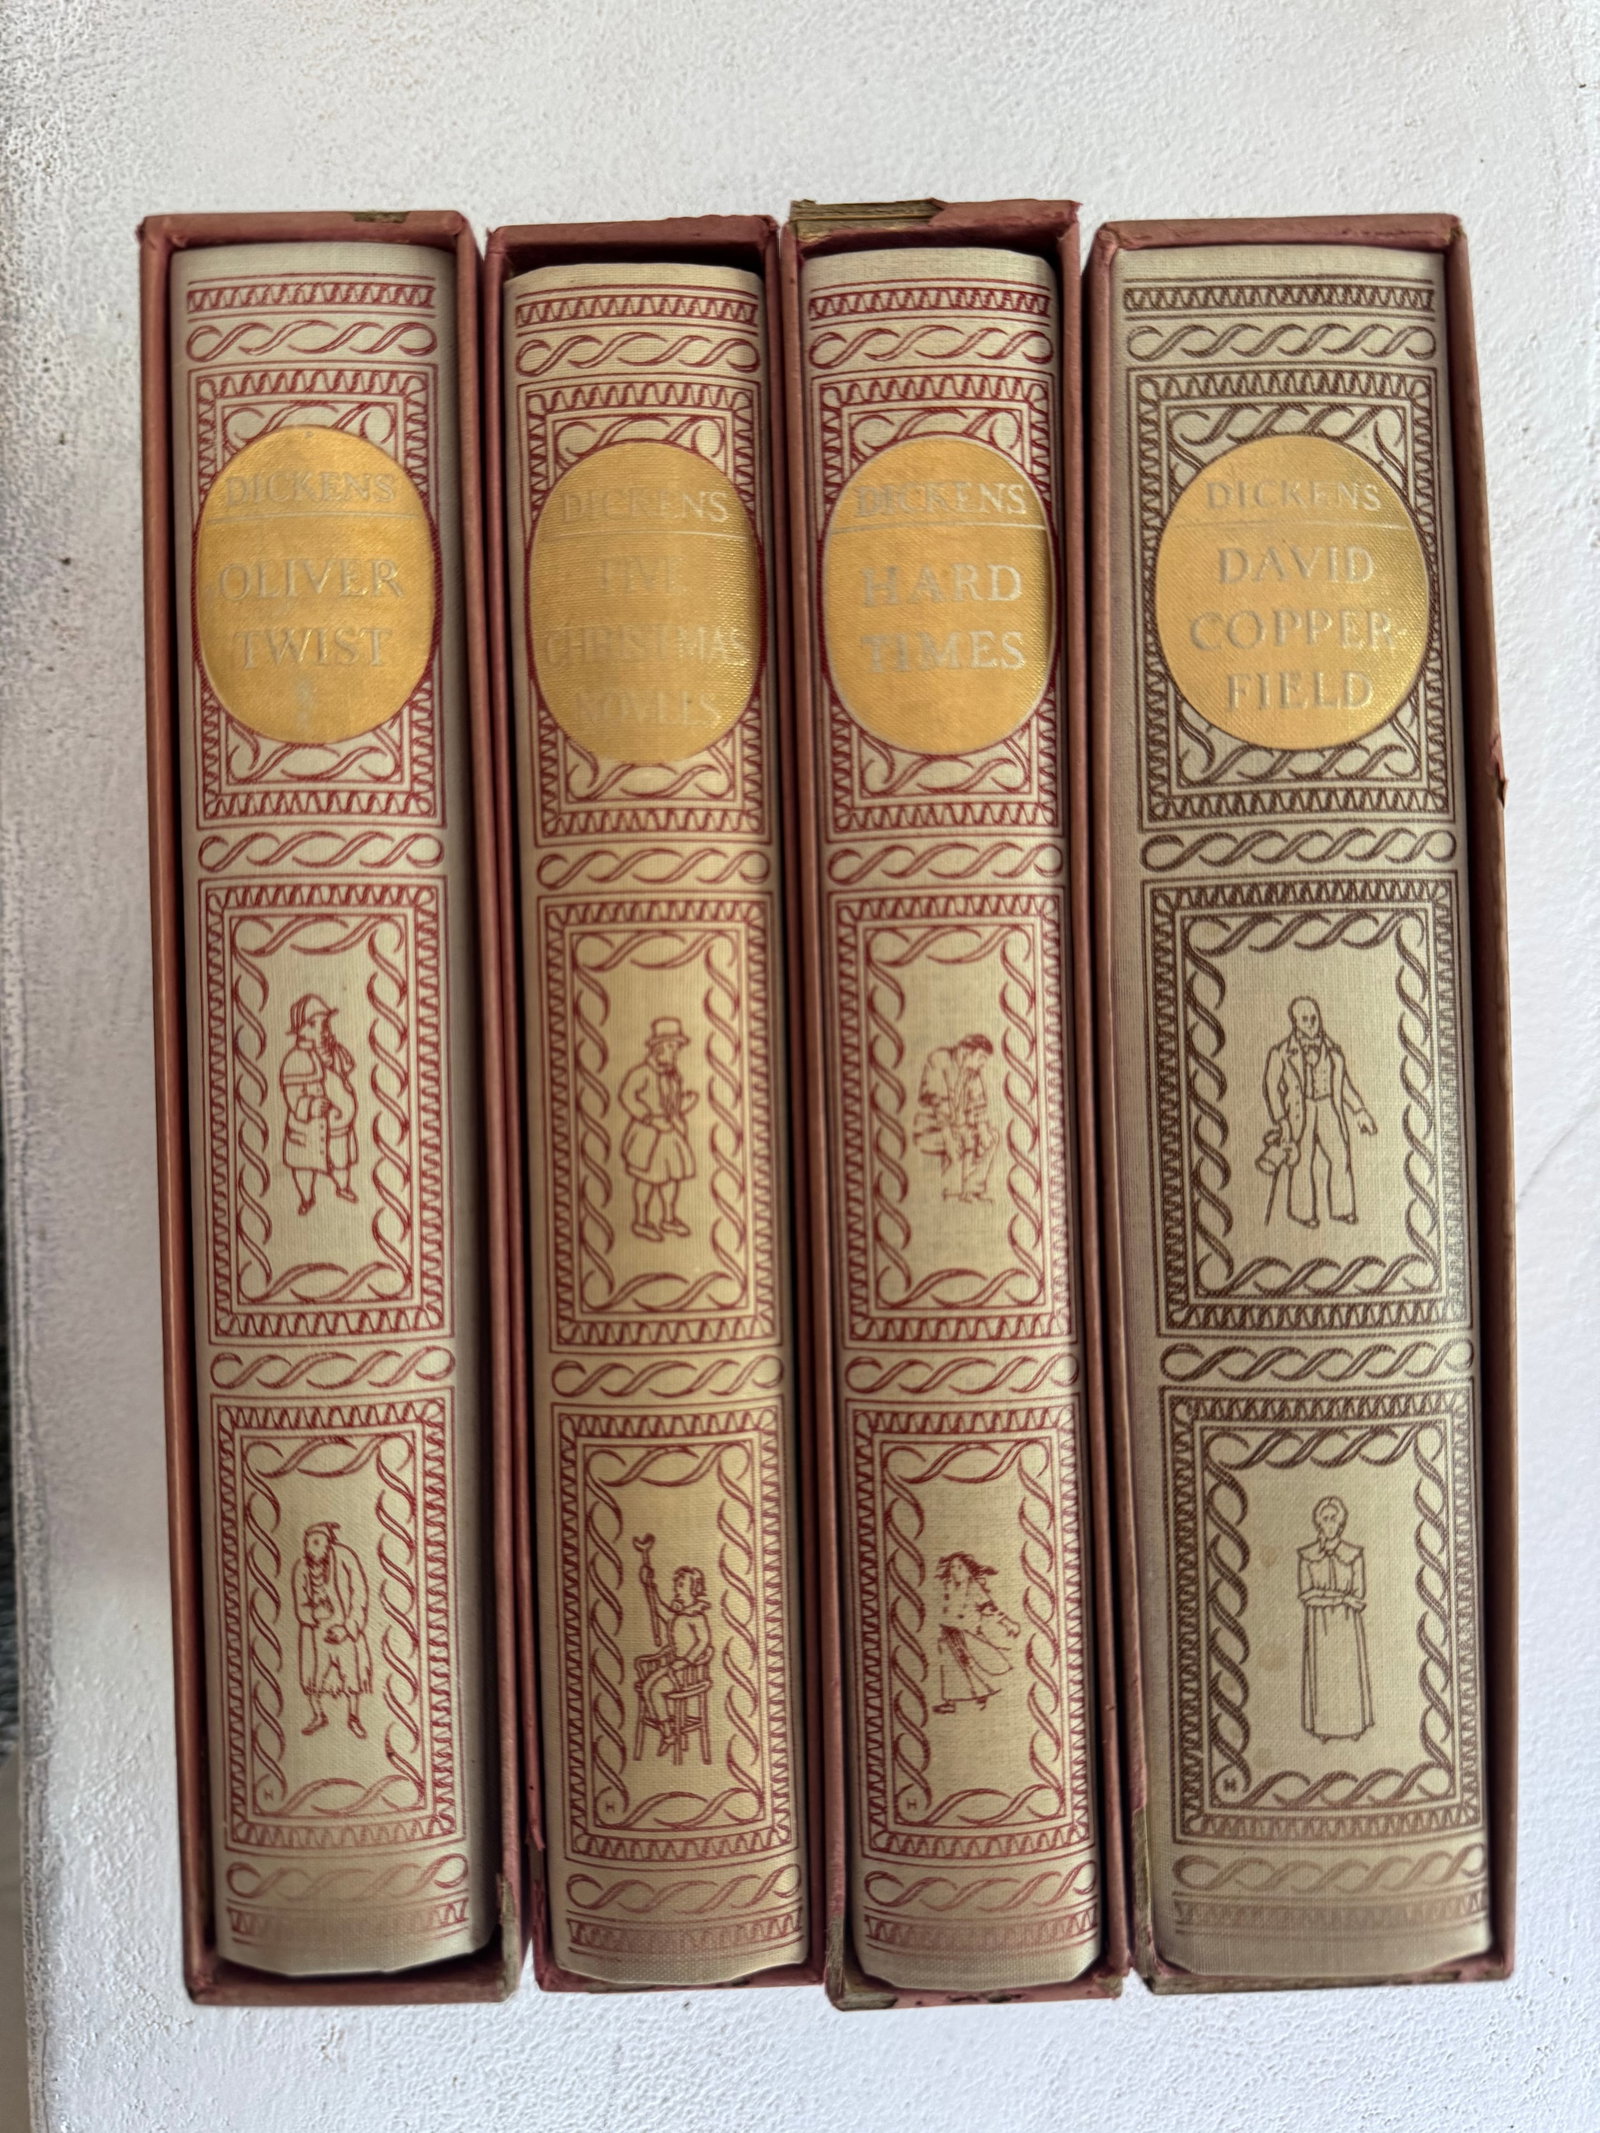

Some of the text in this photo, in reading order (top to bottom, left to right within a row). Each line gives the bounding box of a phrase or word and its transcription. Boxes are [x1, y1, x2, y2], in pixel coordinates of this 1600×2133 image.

[224, 471, 397, 507] DICKENS
[558, 488, 730, 523] DICKENS
[855, 481, 1027, 517] DICKENS
[1205, 479, 1382, 513] DICKENS
[219, 556, 404, 600] OLIVER
[861, 563, 1023, 607] HARD
[1218, 546, 1375, 585] DAVID
[232, 627, 393, 670] TWIST
[861, 630, 1026, 674] TIMES
[1225, 670, 1374, 713] FIELD
